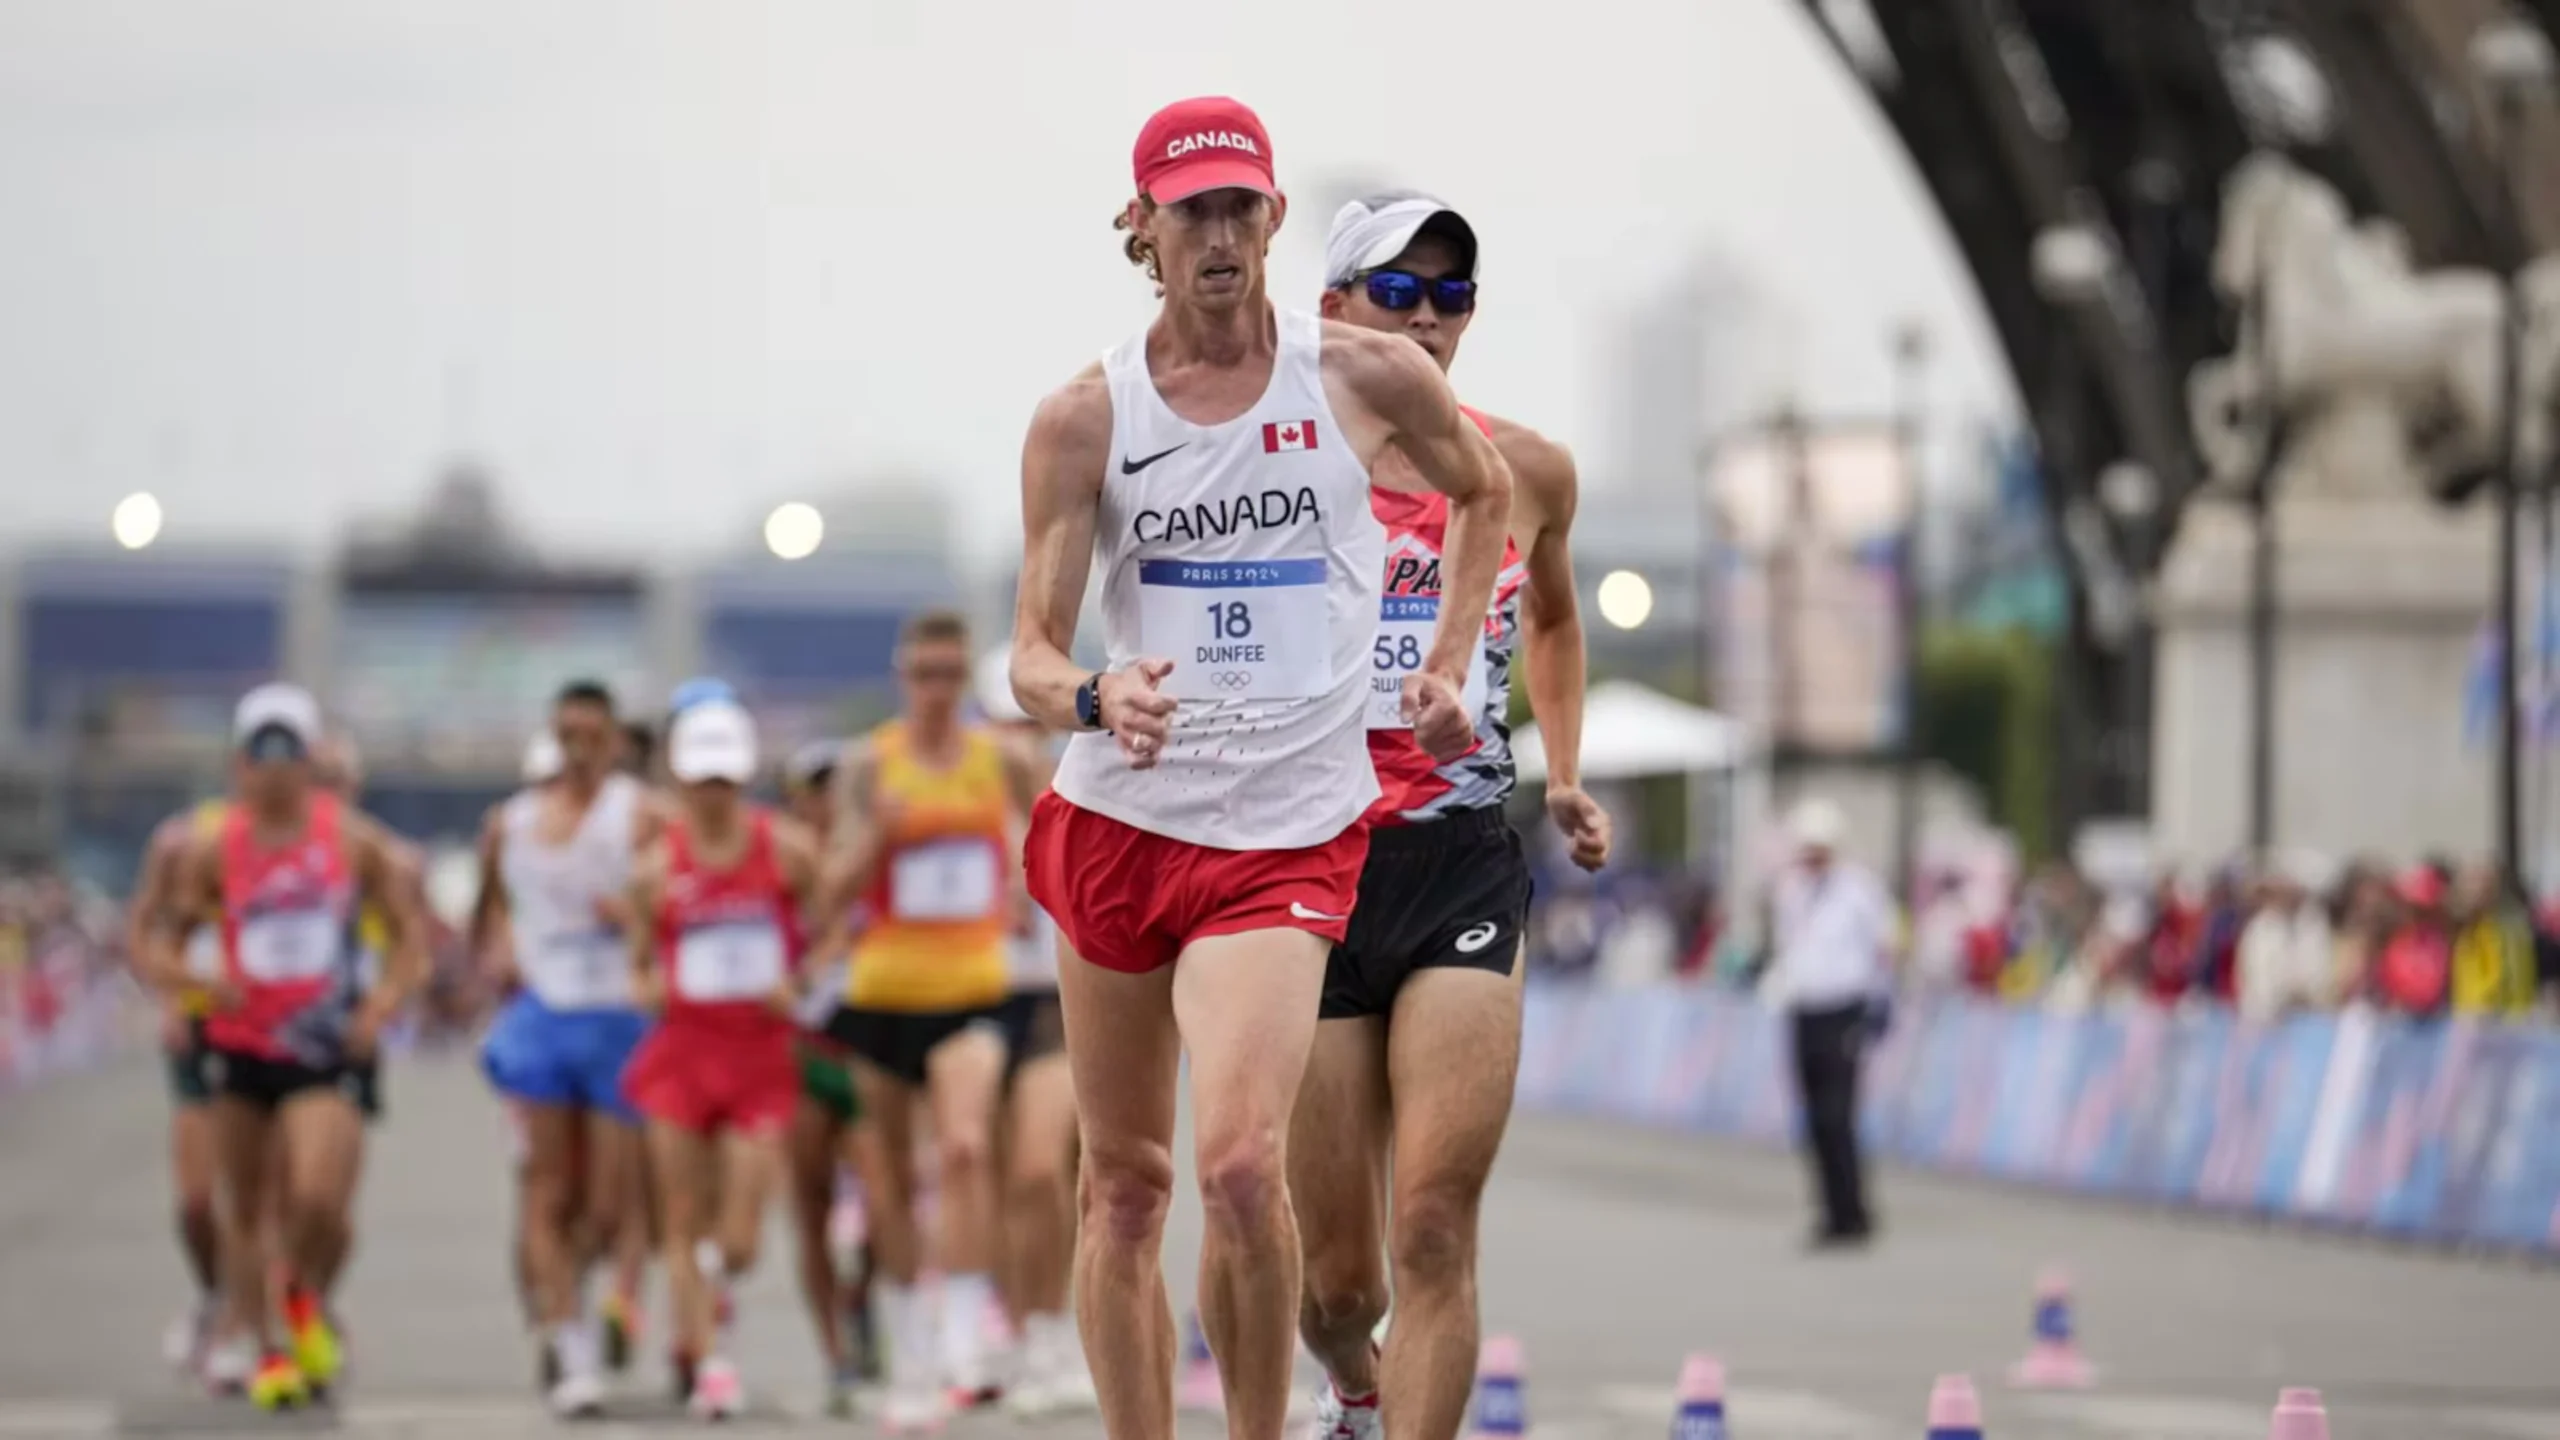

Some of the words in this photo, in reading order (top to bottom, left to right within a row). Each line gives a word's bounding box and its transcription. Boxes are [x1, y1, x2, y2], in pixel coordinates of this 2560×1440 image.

[1167, 130, 1259, 158] CANADA
[1134, 486, 1320, 543] CANADA
[1182, 568, 1228, 581] PARIS
[1234, 567, 1279, 581] 2024
[1385, 558, 1442, 593] PA
[1207, 601, 1252, 639] 18
[1196, 645, 1265, 663] DUNFEE
[1373, 634, 1421, 670] 58
[1371, 676, 1404, 693] AW
